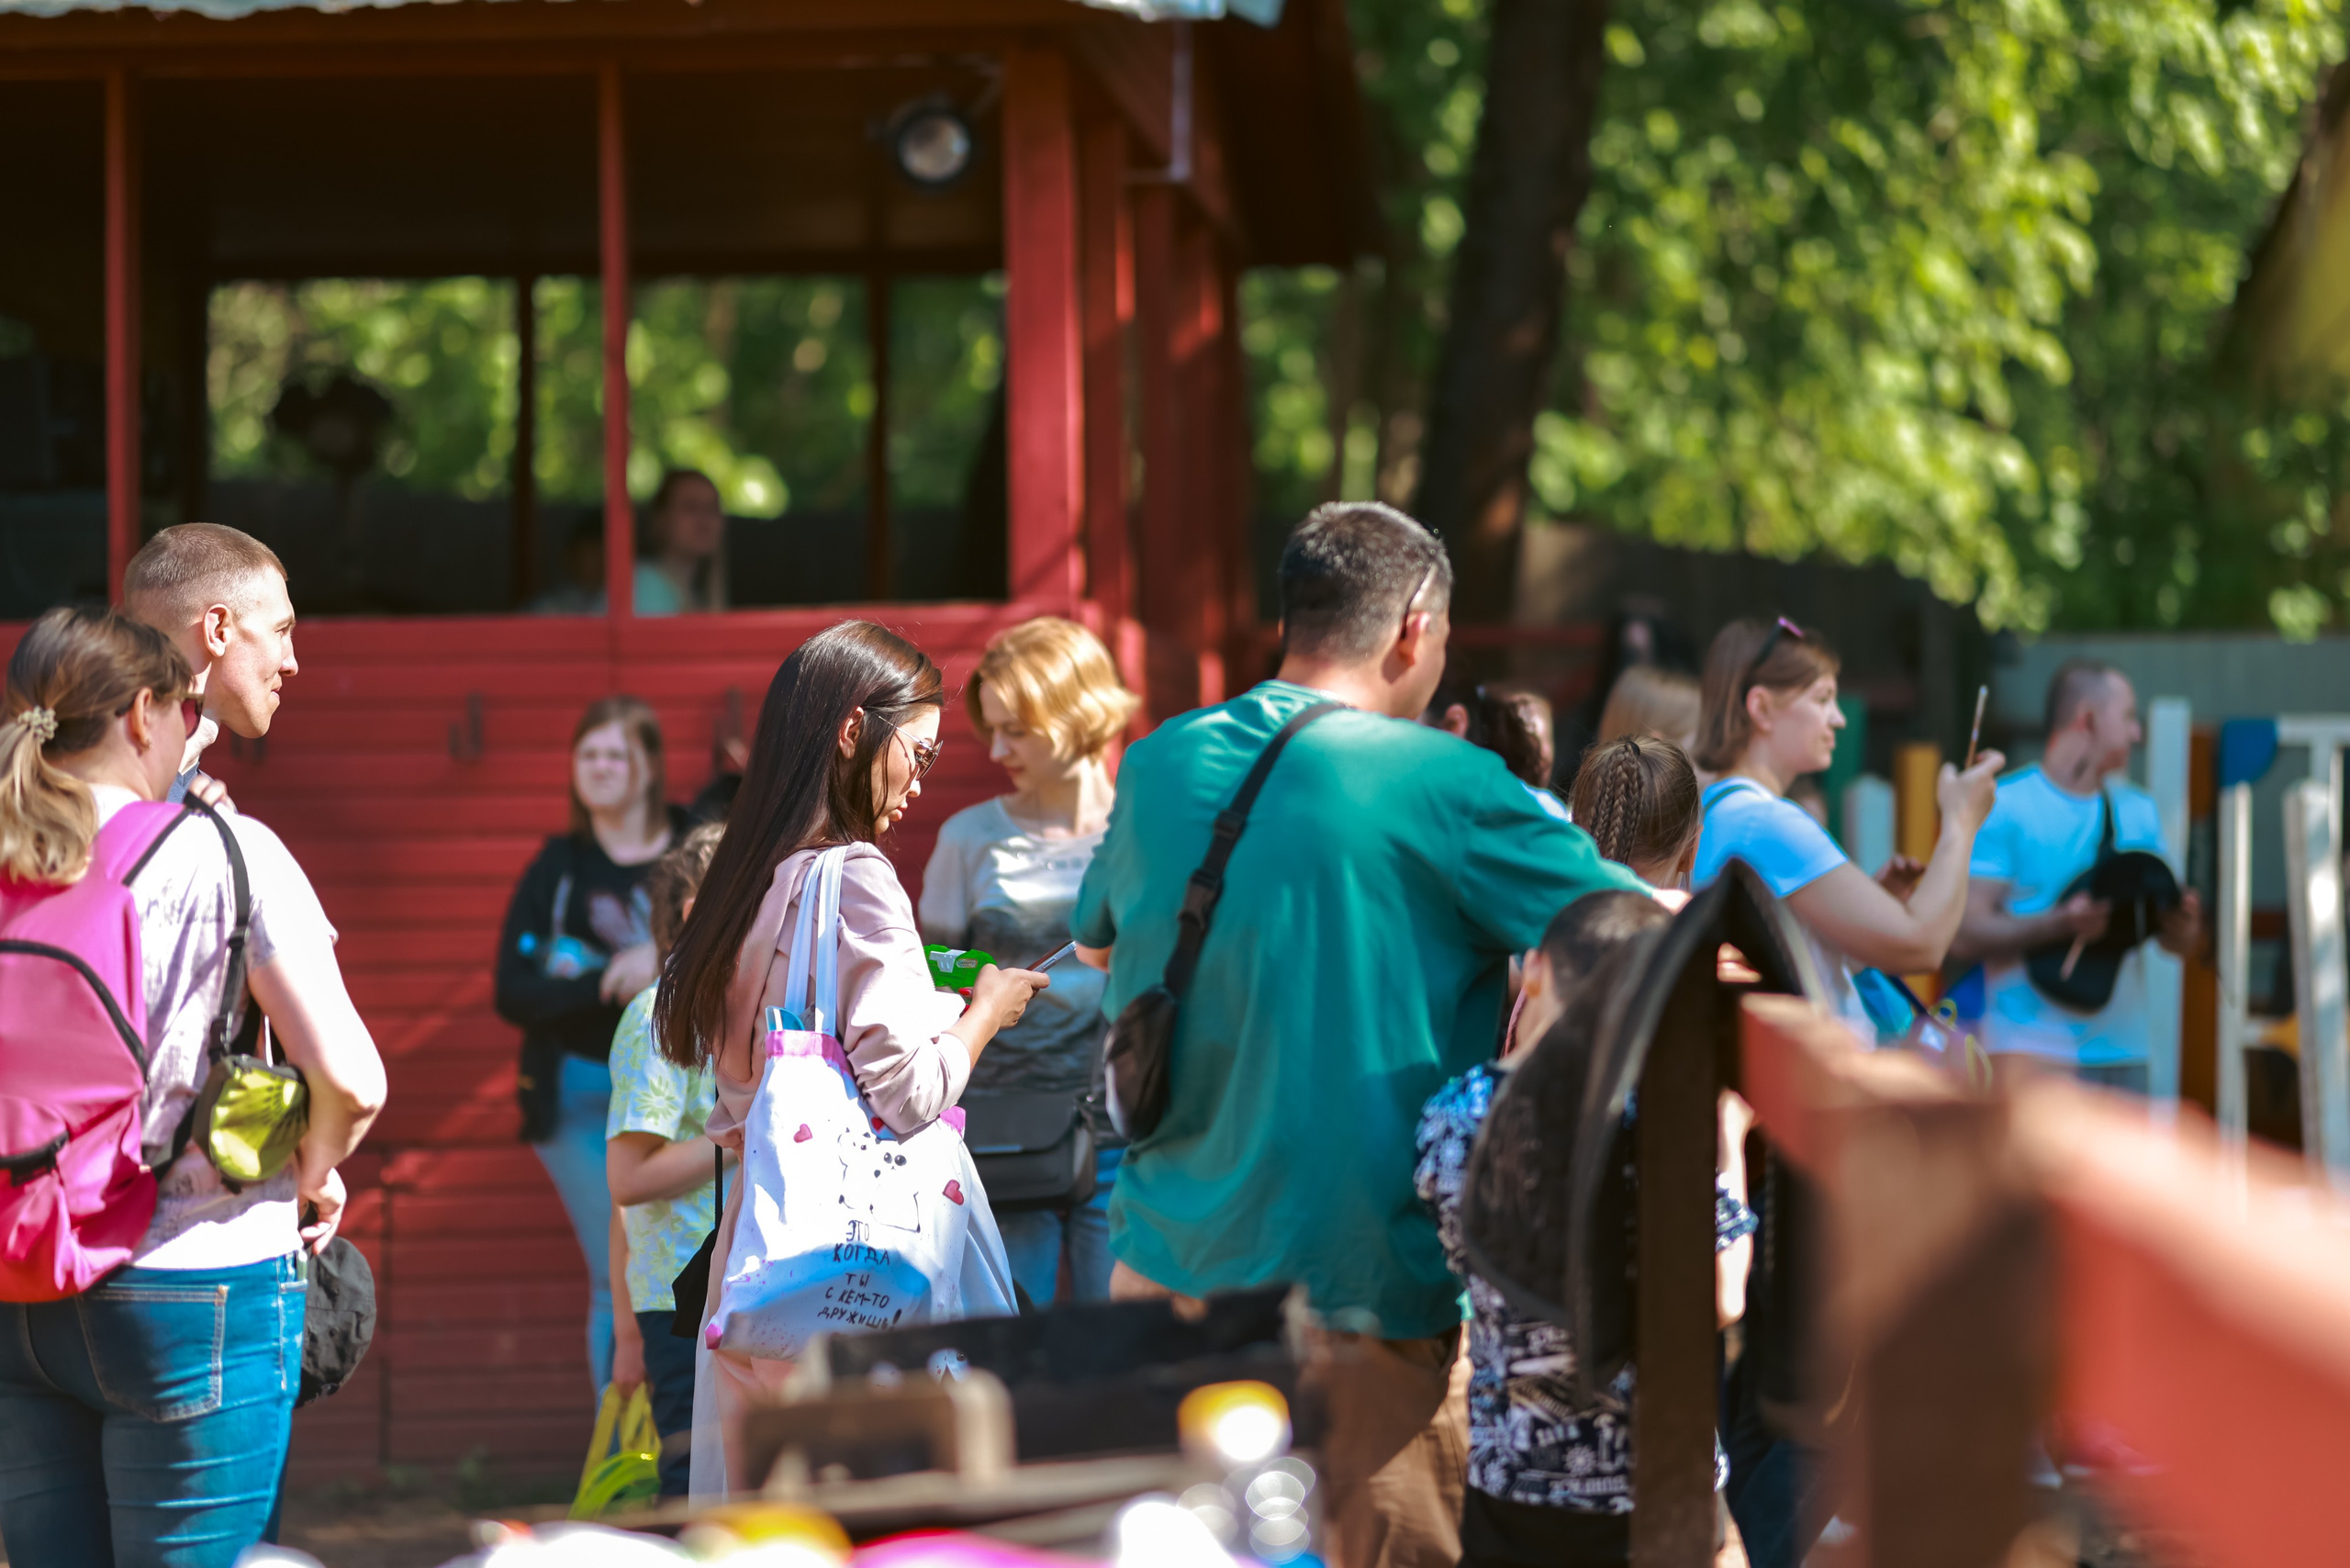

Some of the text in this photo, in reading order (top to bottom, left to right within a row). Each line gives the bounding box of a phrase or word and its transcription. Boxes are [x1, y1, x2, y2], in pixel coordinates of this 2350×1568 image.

[845, 1219, 869, 1242] ЭТО
[833, 1242, 890, 1265] КОГДА
[845, 1272, 869, 1287] ТЫ
[825, 1286, 890, 1308] С КЕМ-ТО
[817, 1305, 902, 1331] ДРУЖИШЬ!
